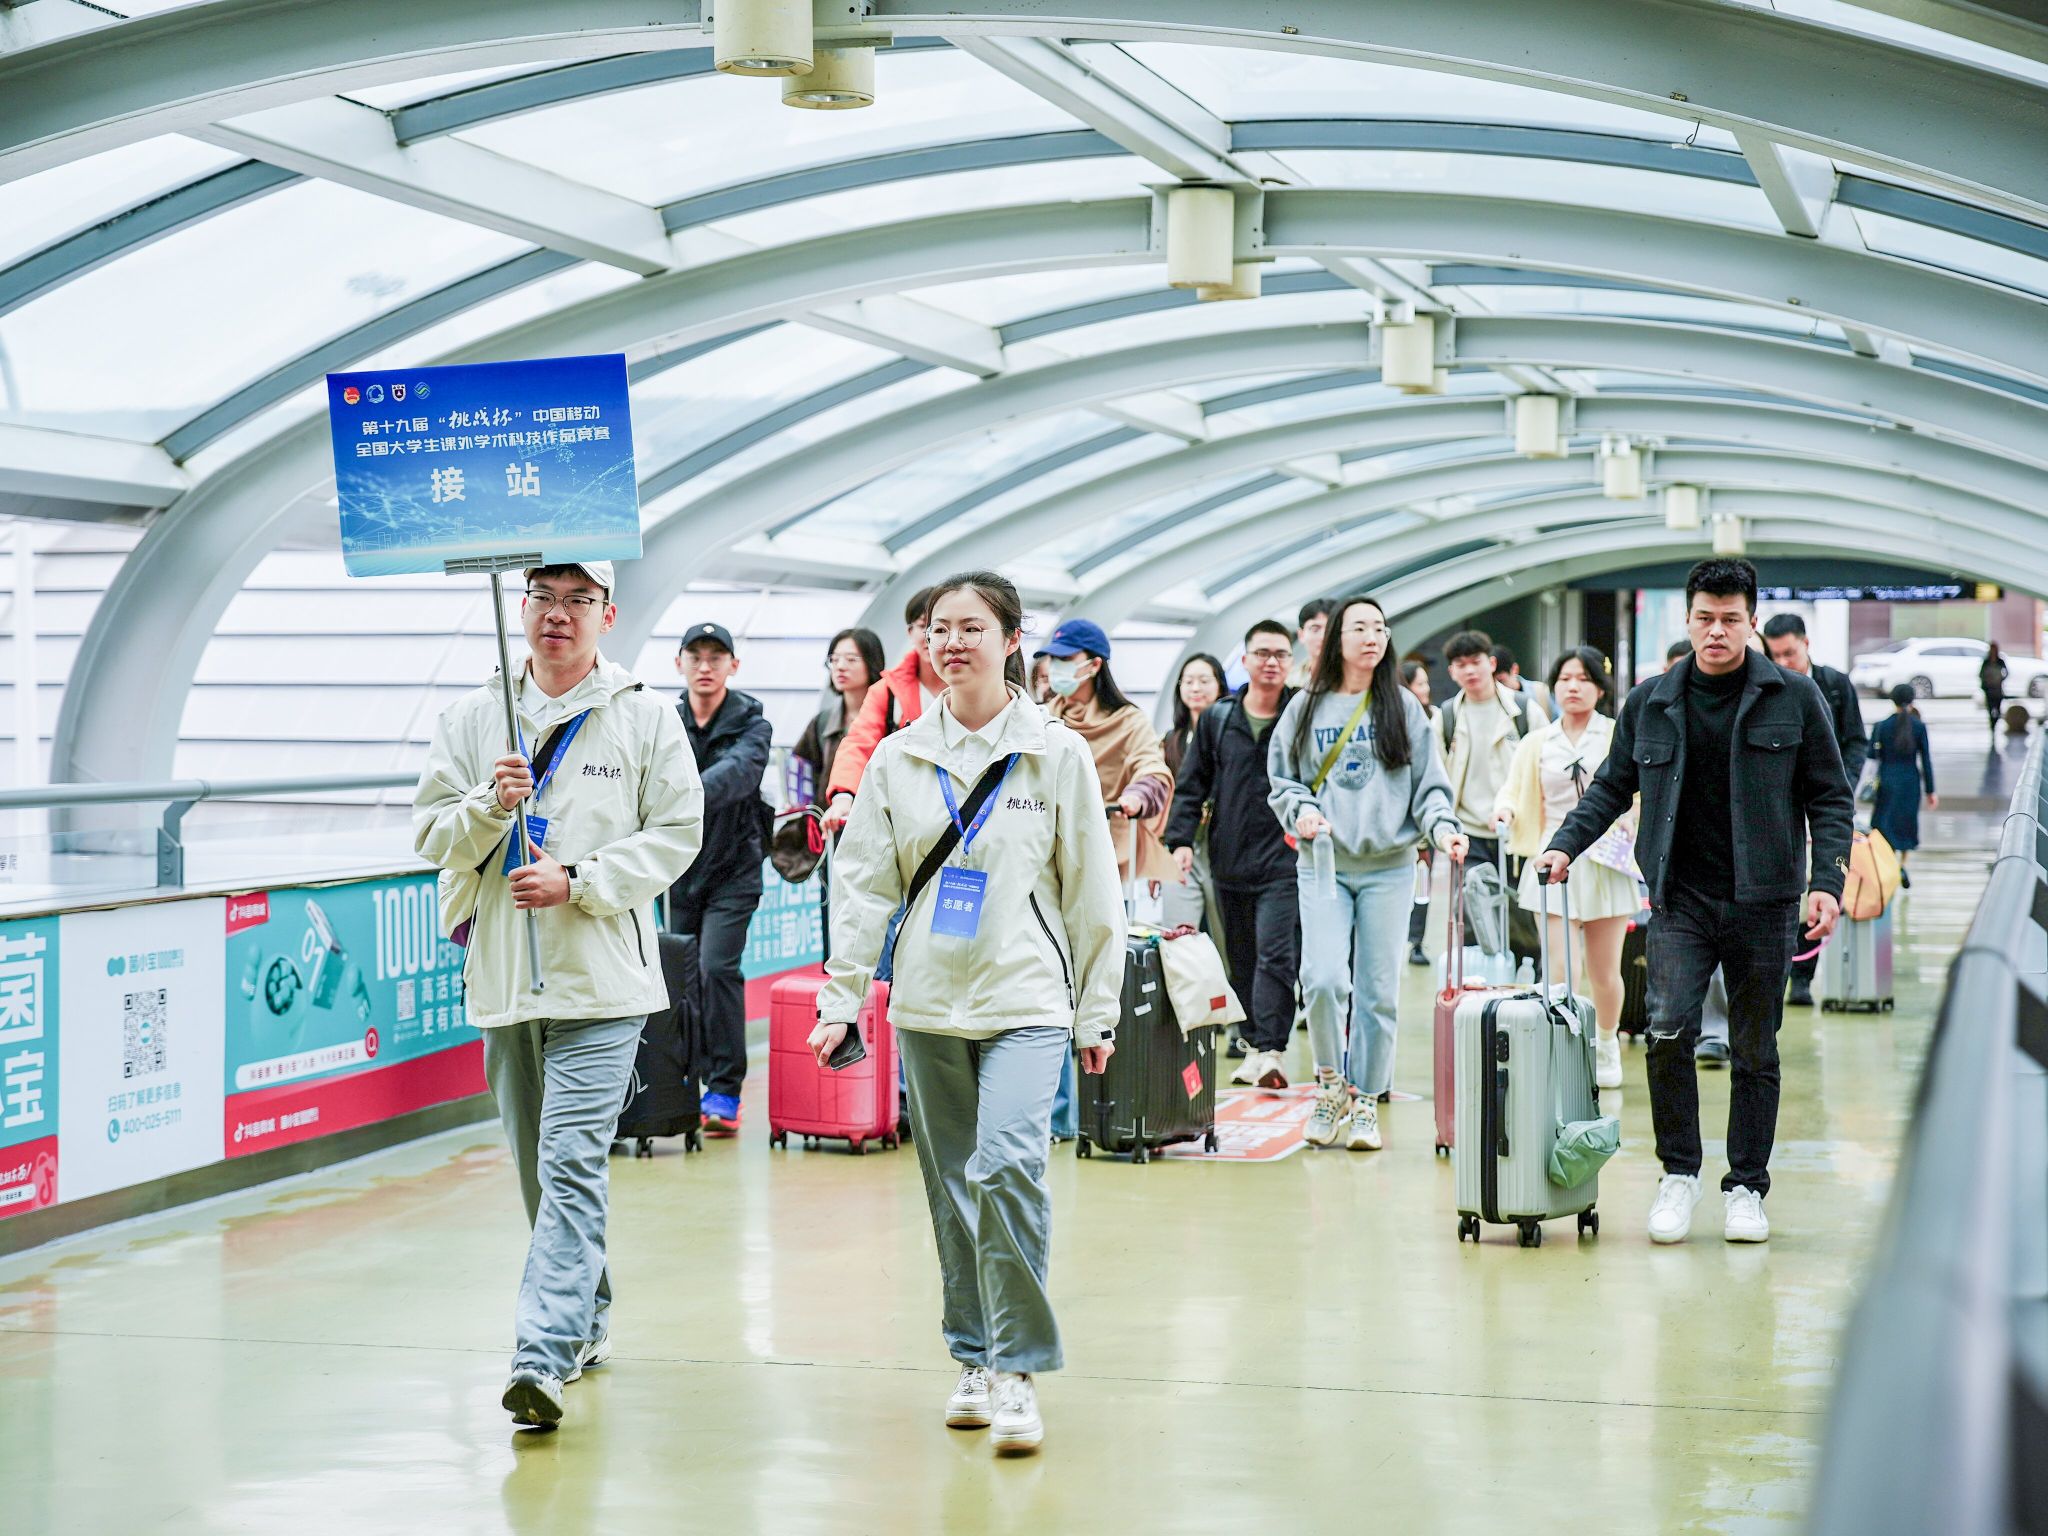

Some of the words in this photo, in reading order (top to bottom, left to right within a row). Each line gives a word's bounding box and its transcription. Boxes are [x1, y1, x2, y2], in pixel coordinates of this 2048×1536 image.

[362, 416, 428, 436] 第十九届
[533, 405, 600, 424] 中国移动
[355, 426, 611, 458] 全国大学生课外学术科技作品竞赛
[430, 466, 467, 504] 接
[505, 461, 542, 498] 站
[582, 763, 622, 780] 挑战杯
[1006, 796, 1046, 813] 挑战杯
[942, 897, 975, 913] 志愿者
[372, 882, 449, 981] 1000
[0, 1050, 45, 1128] 宝
